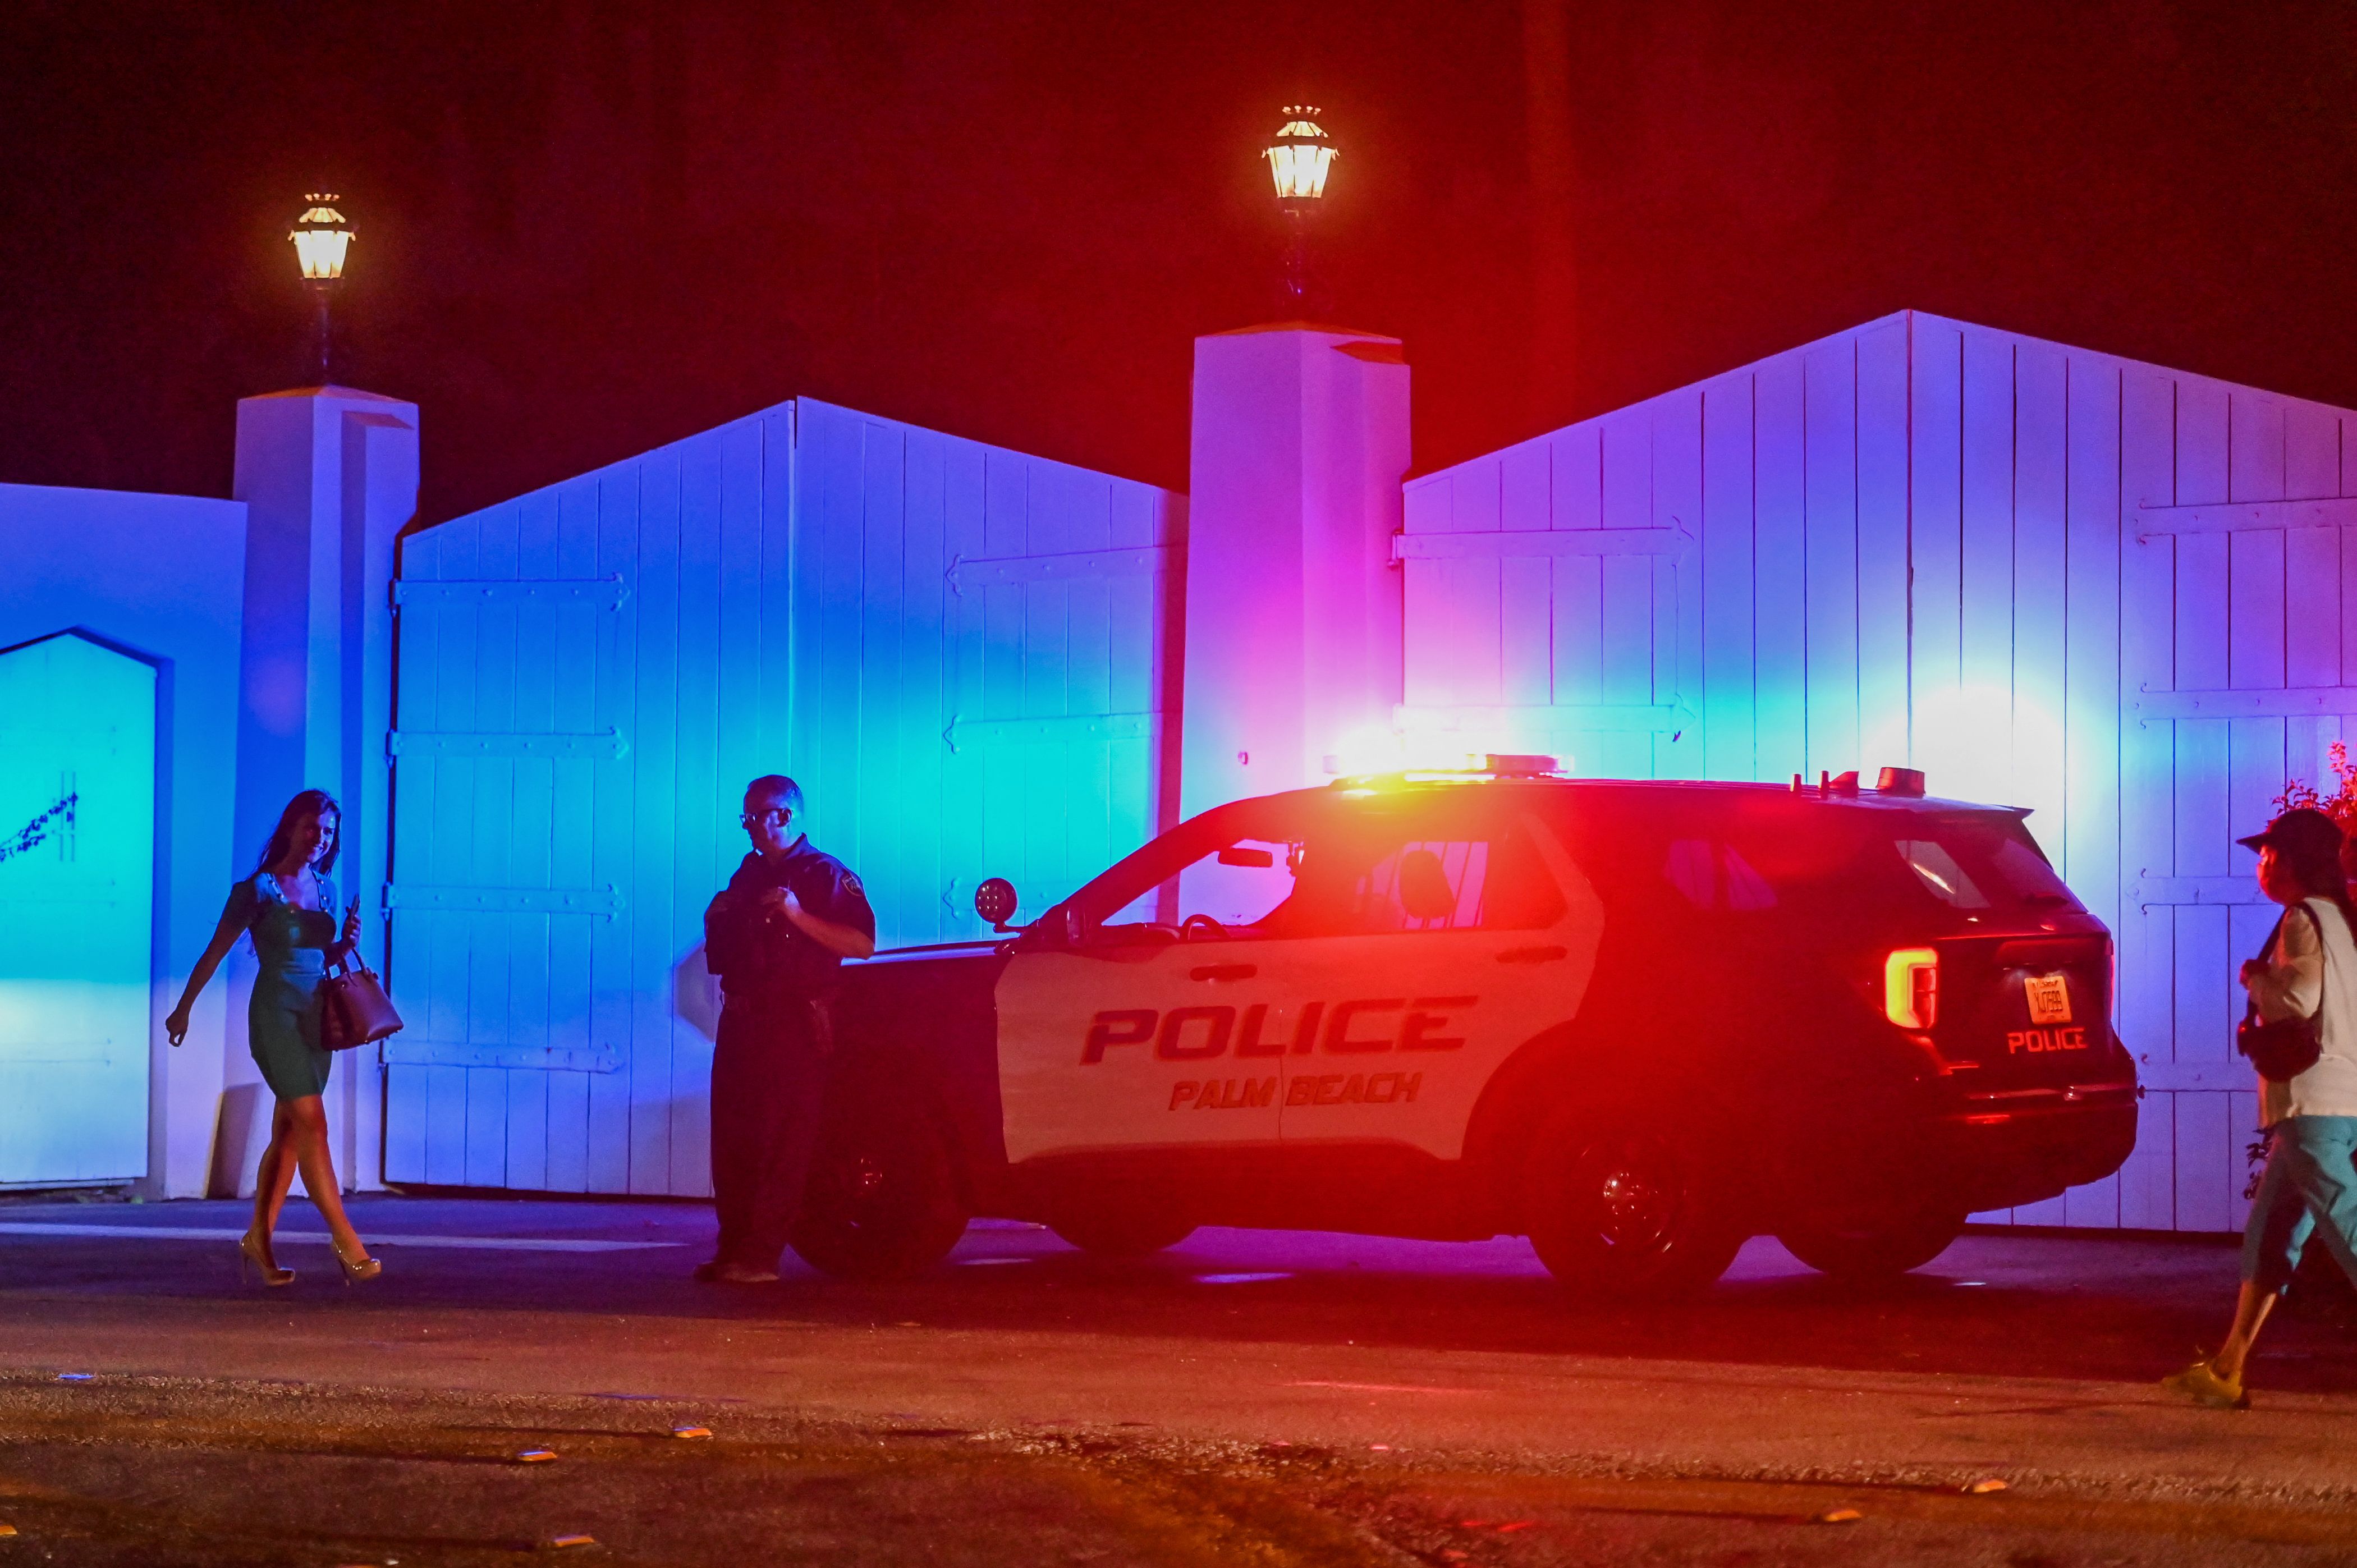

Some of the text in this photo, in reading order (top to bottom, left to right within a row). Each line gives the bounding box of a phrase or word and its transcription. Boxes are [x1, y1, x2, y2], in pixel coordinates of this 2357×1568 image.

[1082, 996, 1478, 1065] POLICE
[2007, 1028, 2088, 1054] POLICE
[1170, 1073, 1420, 1111] PALM BEACH
